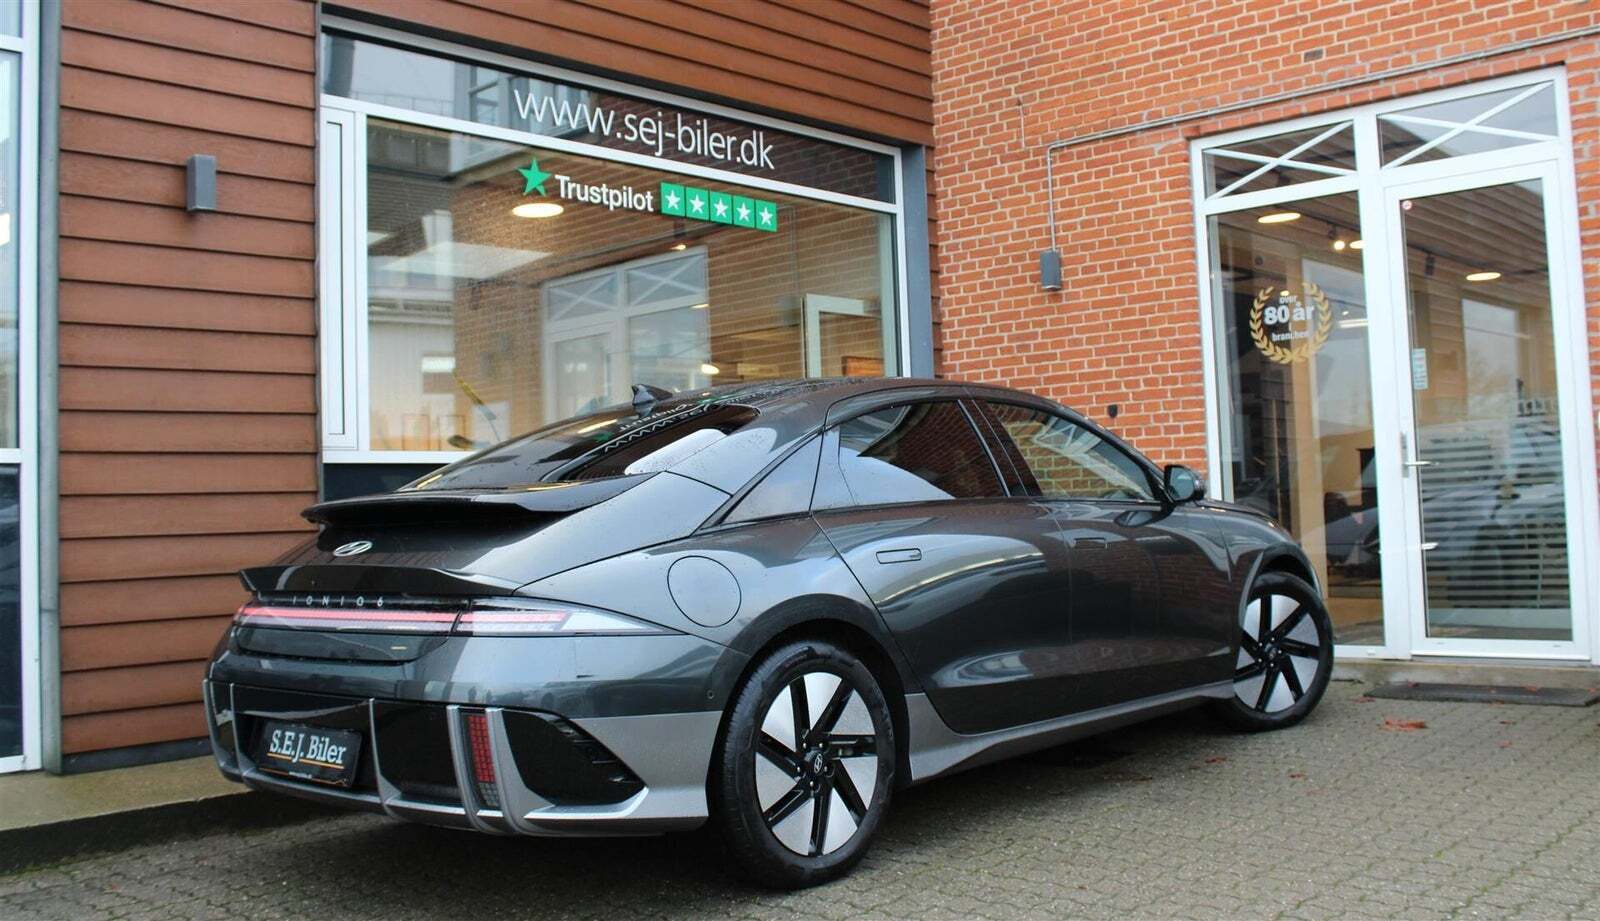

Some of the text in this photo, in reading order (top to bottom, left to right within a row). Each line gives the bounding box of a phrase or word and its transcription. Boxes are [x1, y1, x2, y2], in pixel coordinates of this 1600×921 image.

[513, 89, 775, 170] www.sej-biler.dk
[554, 174, 654, 212] Trustpilot
[1263, 301, 1315, 325] 80 år
[269, 729, 347, 764] S.E.J. Biler
